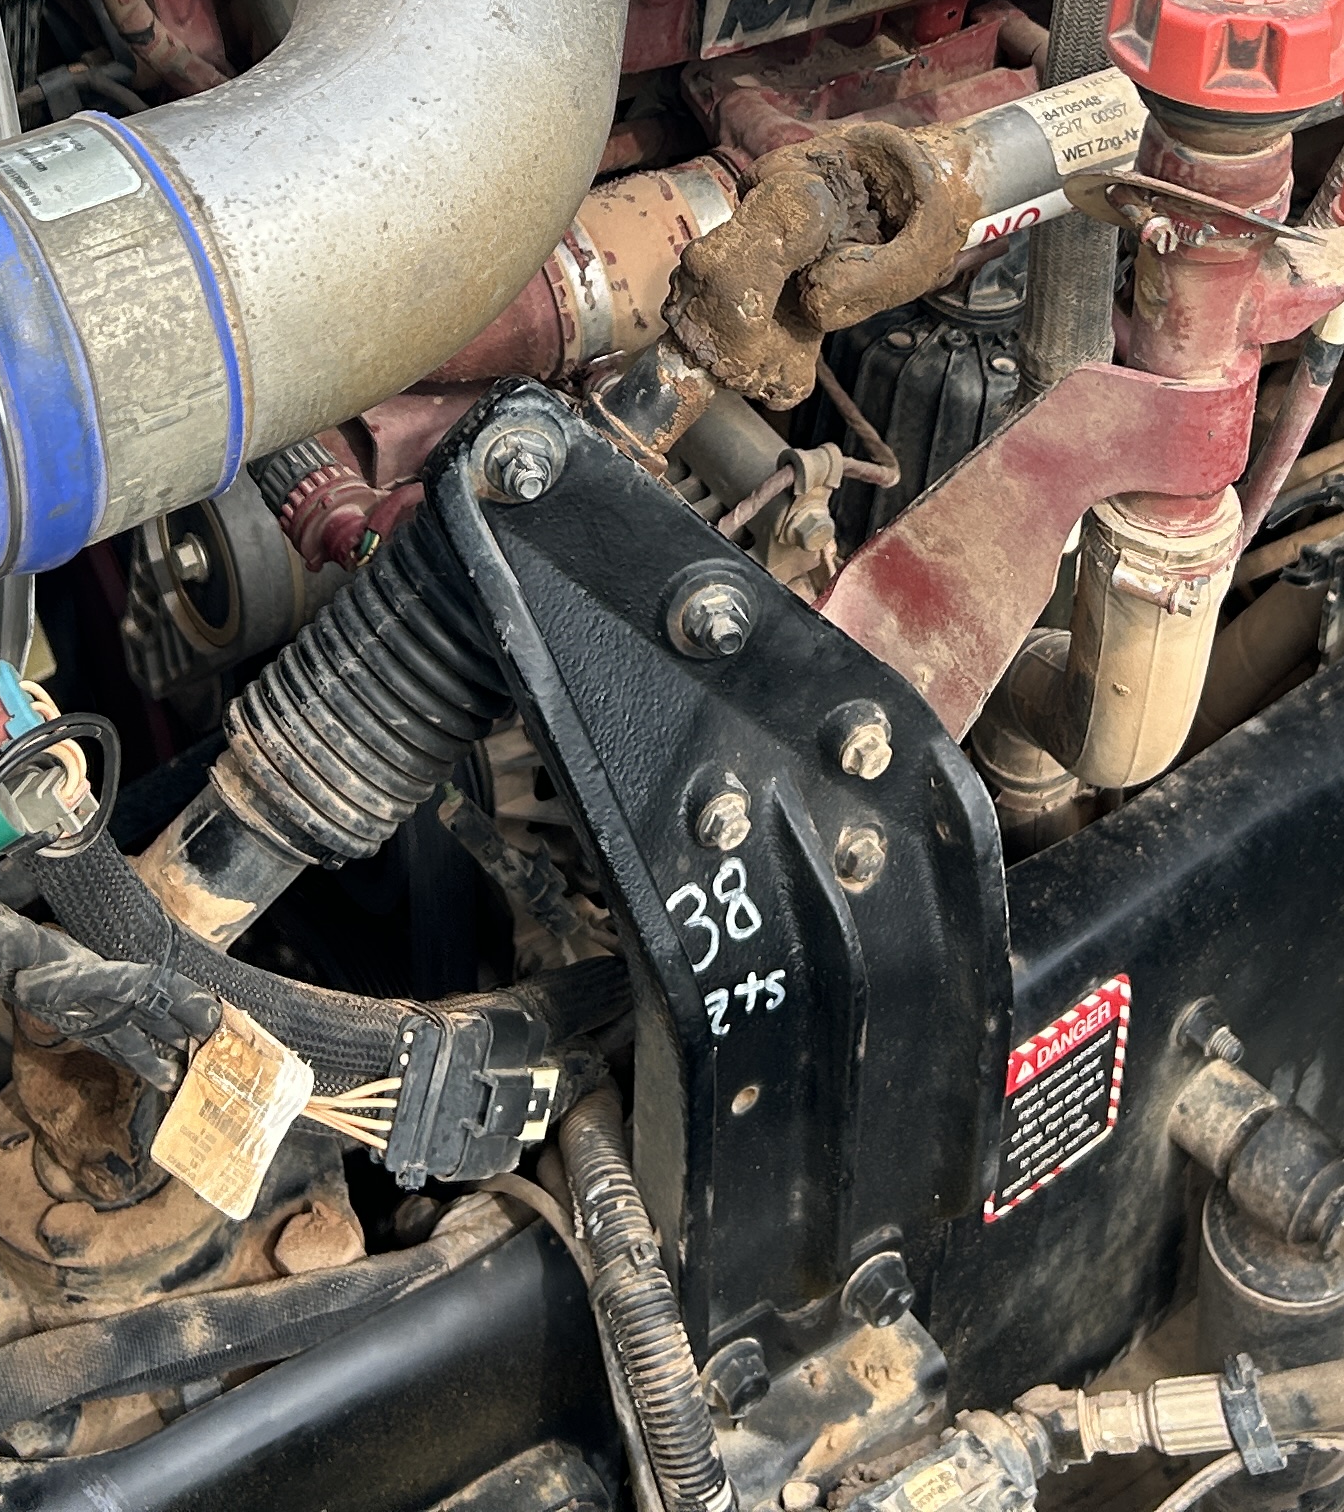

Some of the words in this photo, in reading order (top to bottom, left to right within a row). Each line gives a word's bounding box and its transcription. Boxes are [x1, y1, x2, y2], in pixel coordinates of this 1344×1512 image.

[1028, 87, 1076, 107] MACK
[1062, 140, 1094, 163] WET
[665, 856, 763, 973] 38
[1037, 1001, 1112, 1068] DANGER
[1011, 1083, 1039, 1110] Avoid
[1039, 1061, 1073, 1090] serious
[1072, 1030, 1111, 1067] personal
[1047, 1073, 1079, 1100] remain
[1079, 1055, 1102, 1077] clear
[1011, 1128, 1022, 1143] of
[1022, 1119, 1038, 1136] fan
[1038, 1100, 1064, 1123] when
[1065, 1076, 1095, 1105] engine
[1095, 1069, 1105, 1082] is
[1045, 1116, 1063, 1135] Fan
[1063, 1102, 1084, 1121] may
[1084, 1084, 1105, 1106] start
[1020, 1156, 1031, 1169] to
[1031, 1137, 1057, 1161] rotate
[1057, 1127, 1069, 1141] at
[1069, 1113, 1090, 1132] high
[1001, 1170, 1031, 1198] speed
[1031, 1147, 1064, 1176] without
